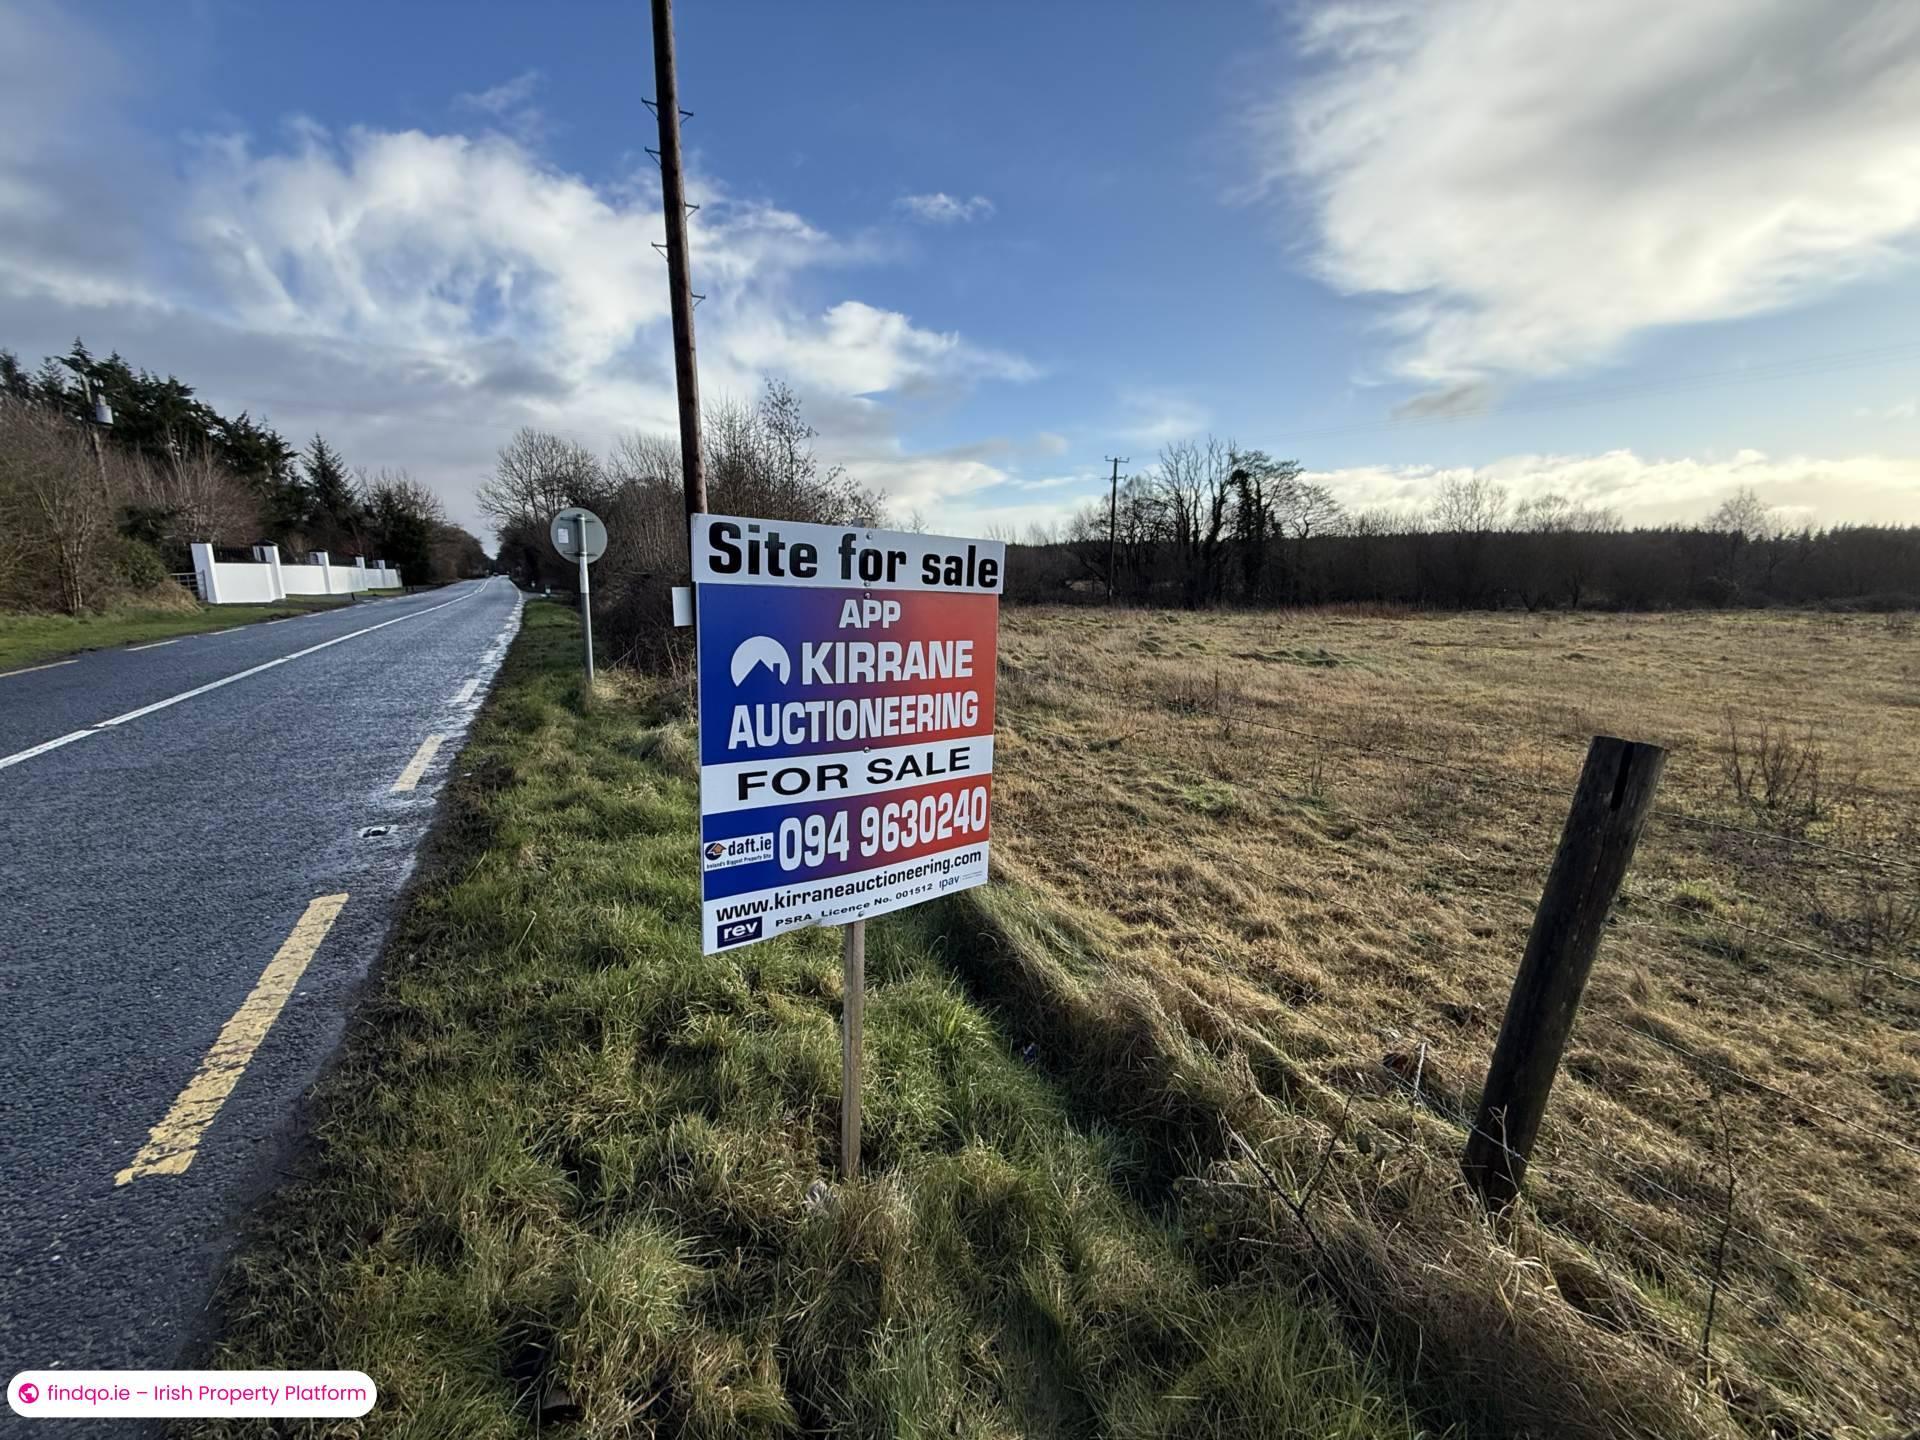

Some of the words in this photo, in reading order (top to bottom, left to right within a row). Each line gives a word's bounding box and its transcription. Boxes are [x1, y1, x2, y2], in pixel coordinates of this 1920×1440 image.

[708, 522, 818, 579] Site
[838, 533, 907, 583] for
[921, 545, 999, 588] sale
[838, 599, 901, 629] APP
[801, 640, 974, 686] KIRRANE
[728, 690, 979, 750] AUCTIONEERING
[737, 763, 849, 801] FOR
[866, 746, 971, 785] SALE
[728, 836, 772, 857] daft.ie
[778, 810, 850, 872] 094
[860, 786, 988, 857] 9630240
[716, 850, 982, 922] www.kirraneauctioneering.com
[775, 913, 812, 927] PSRA
[821, 901, 871, 917] Licence
[873, 897, 892, 906] No.
[895, 883, 933, 899] 001512
[723, 921, 758, 939] rev
